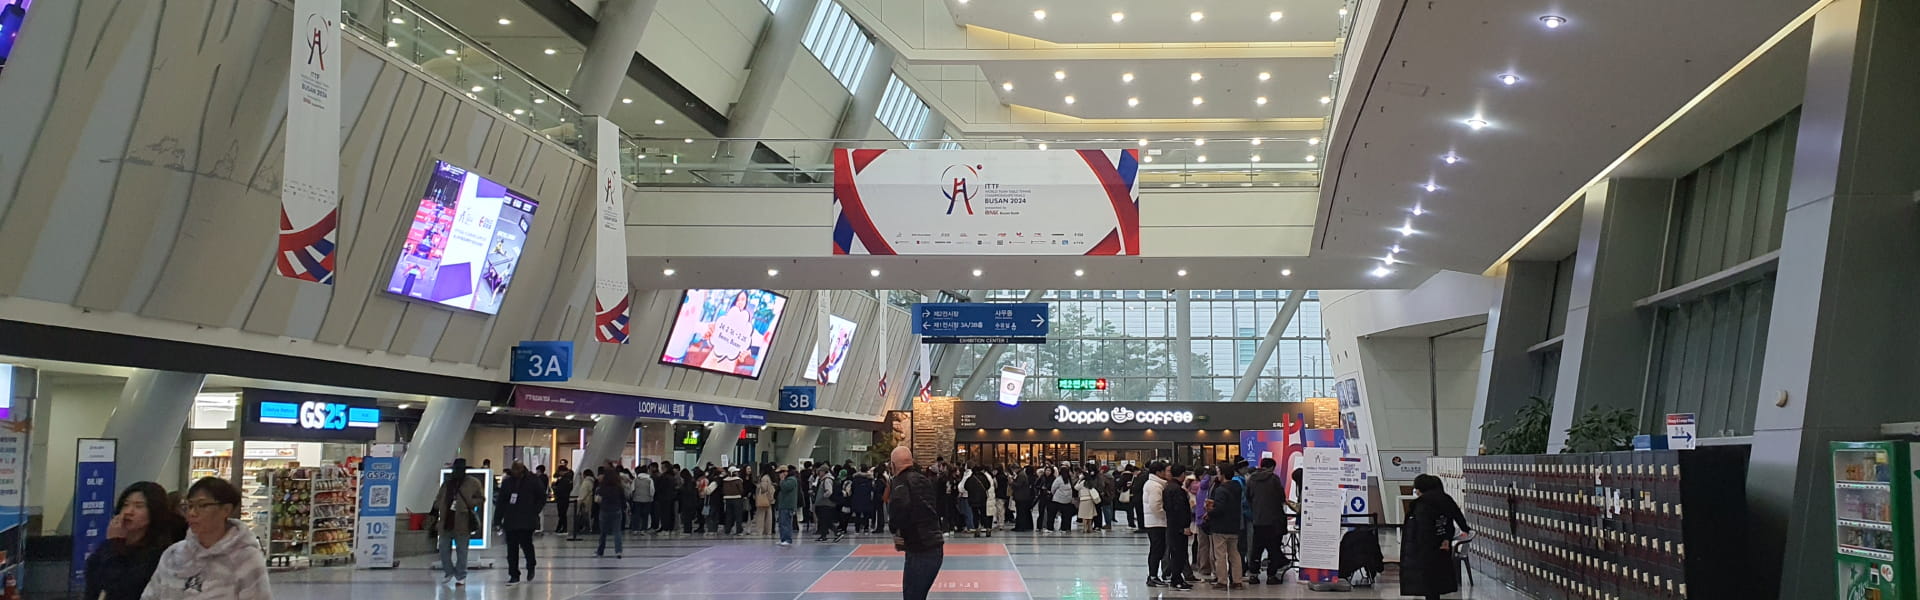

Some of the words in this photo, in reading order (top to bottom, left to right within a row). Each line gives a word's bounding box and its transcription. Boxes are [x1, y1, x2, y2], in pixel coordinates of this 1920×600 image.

[528, 355, 562, 377] 3A
[639, 401, 657, 414] LOOPY
[657, 402, 671, 415] HALL
[789, 394, 810, 408] 3B
[300, 401, 347, 430] GS25
[1136, 411, 1193, 424] coffee
[366, 471, 378, 479] GS
[379, 471, 394, 480] Pay
